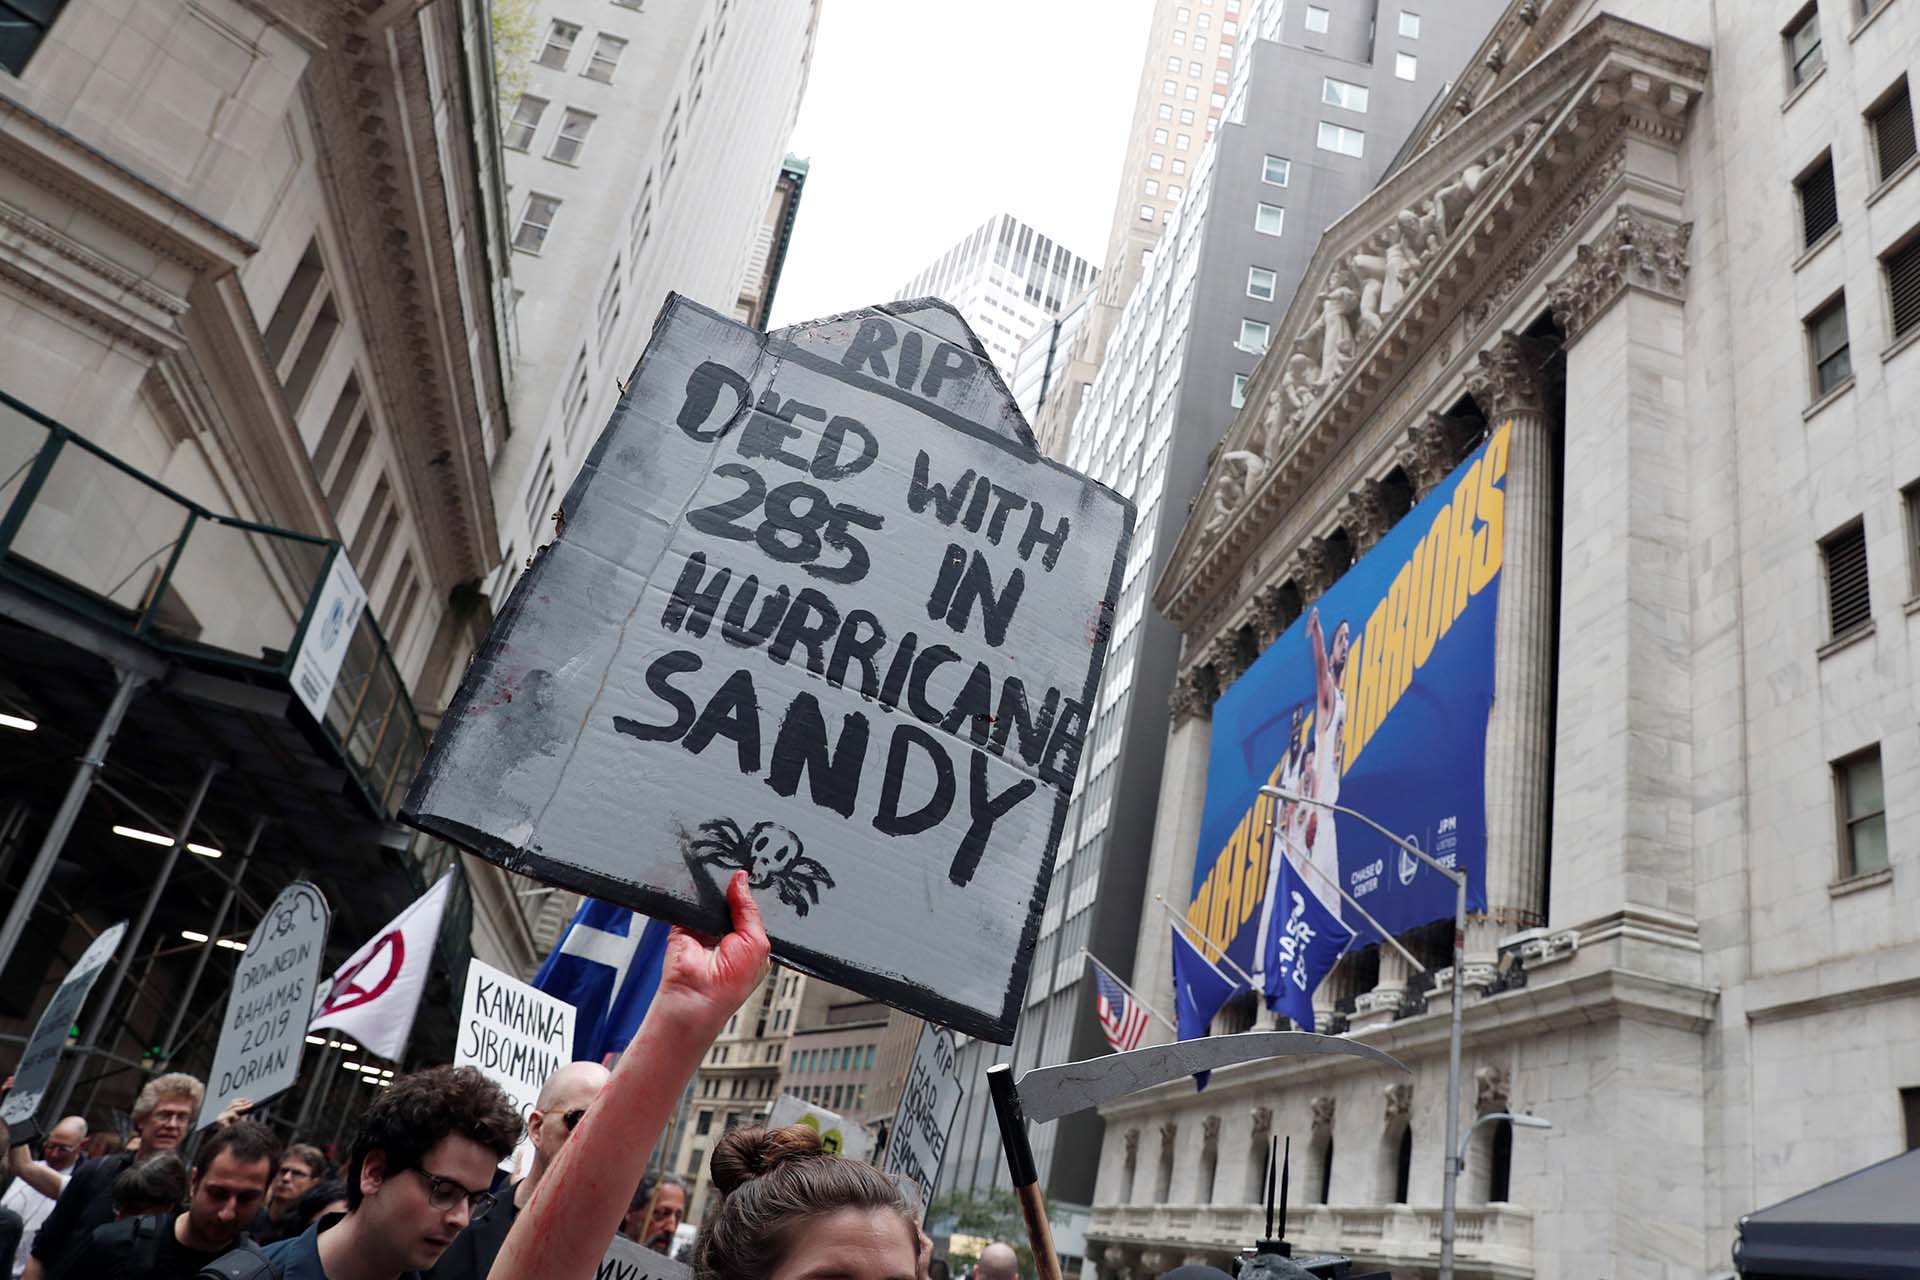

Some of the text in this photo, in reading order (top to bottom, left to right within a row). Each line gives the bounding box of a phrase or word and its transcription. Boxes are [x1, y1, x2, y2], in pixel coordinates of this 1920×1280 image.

[841, 316, 977, 399] RIP
[676, 360, 1070, 573] DIED WITH
[686, 462, 1026, 647] 285 IN
[660, 551, 1092, 796] HURRICANE
[612, 650, 1037, 888] SANDY
[1351, 863, 1376, 886] CHASE
[1353, 877, 1378, 899] CENTER
[240, 940, 313, 995] DROWNED IN
[234, 977, 305, 1031] BAHAMAS
[475, 976, 565, 1052] KANANWA
[240, 1009, 291, 1055] 2019
[933, 1036, 953, 1078] RIP
[218, 1045, 290, 1099] DORIAN
[914, 1055, 938, 1110] HAD
[899, 1110, 914, 1139] TO
[905, 1076, 945, 1163] NOWHERE
